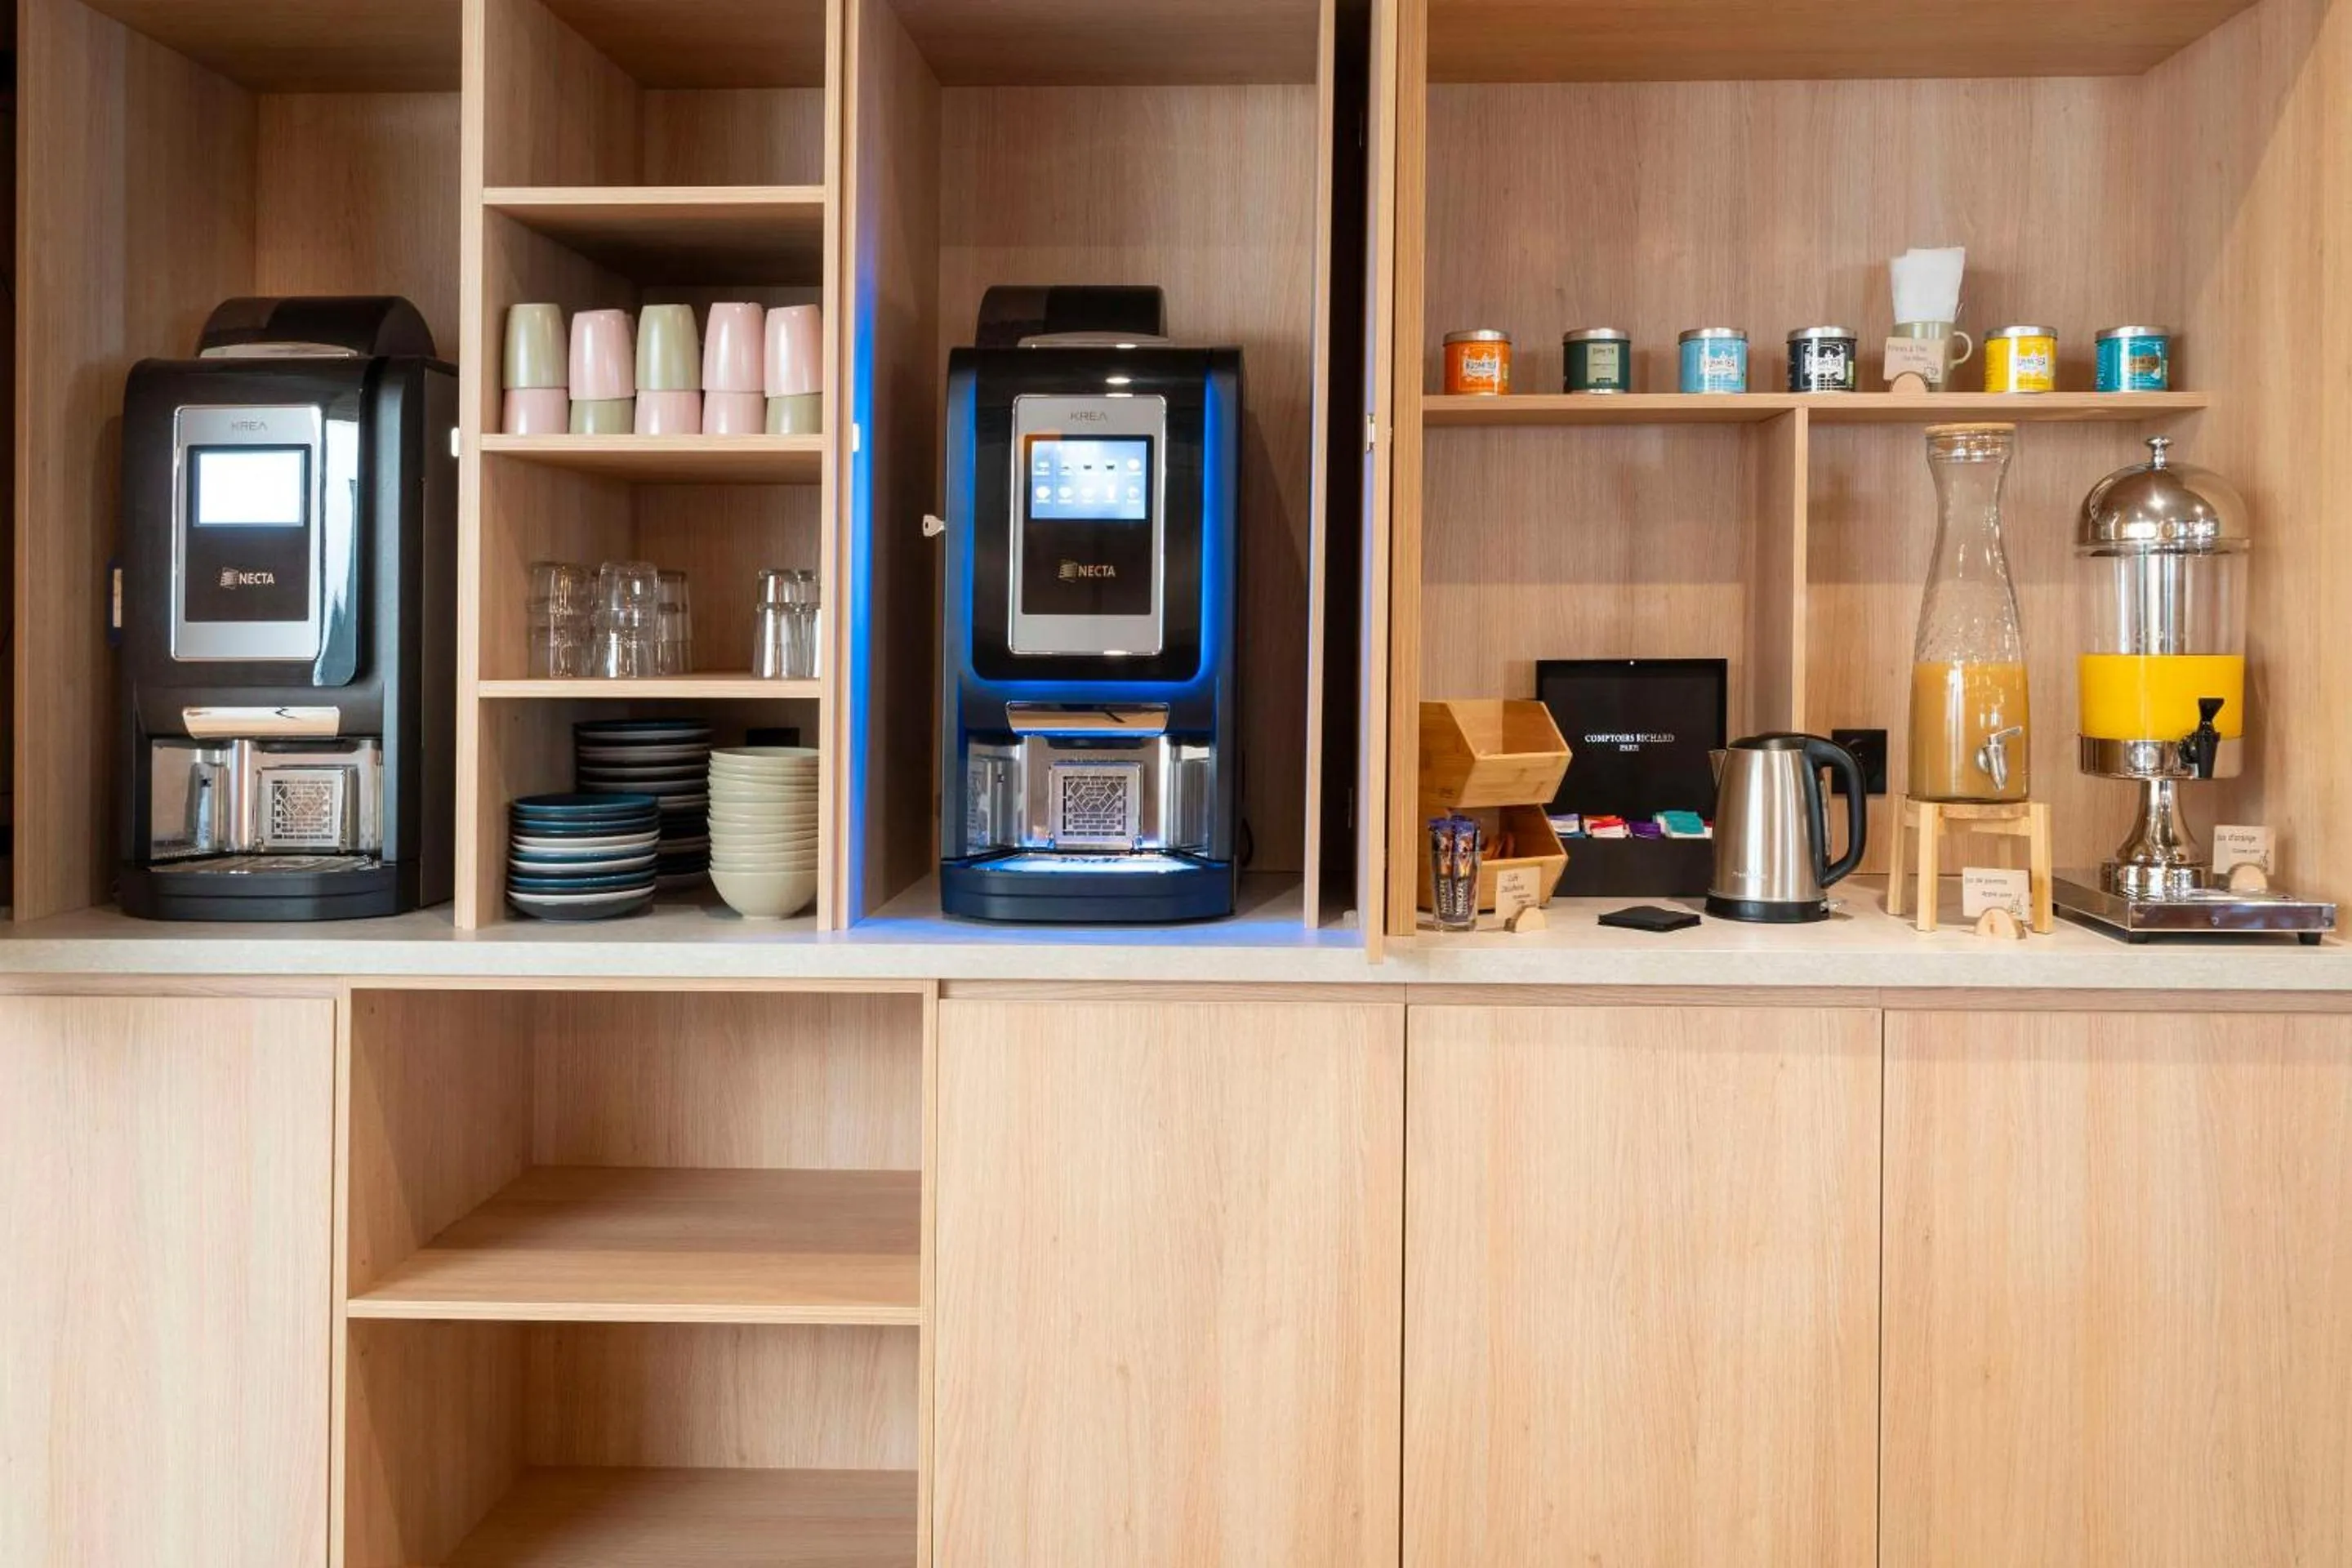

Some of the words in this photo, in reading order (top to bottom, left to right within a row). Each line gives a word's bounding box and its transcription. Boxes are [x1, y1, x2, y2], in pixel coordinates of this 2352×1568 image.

[1078, 565, 1116, 577] NECTA
[238, 572, 275, 585] NECTA
[1584, 734, 1634, 742] COMPTOIRS
[1636, 733, 1675, 742] RICHARD
